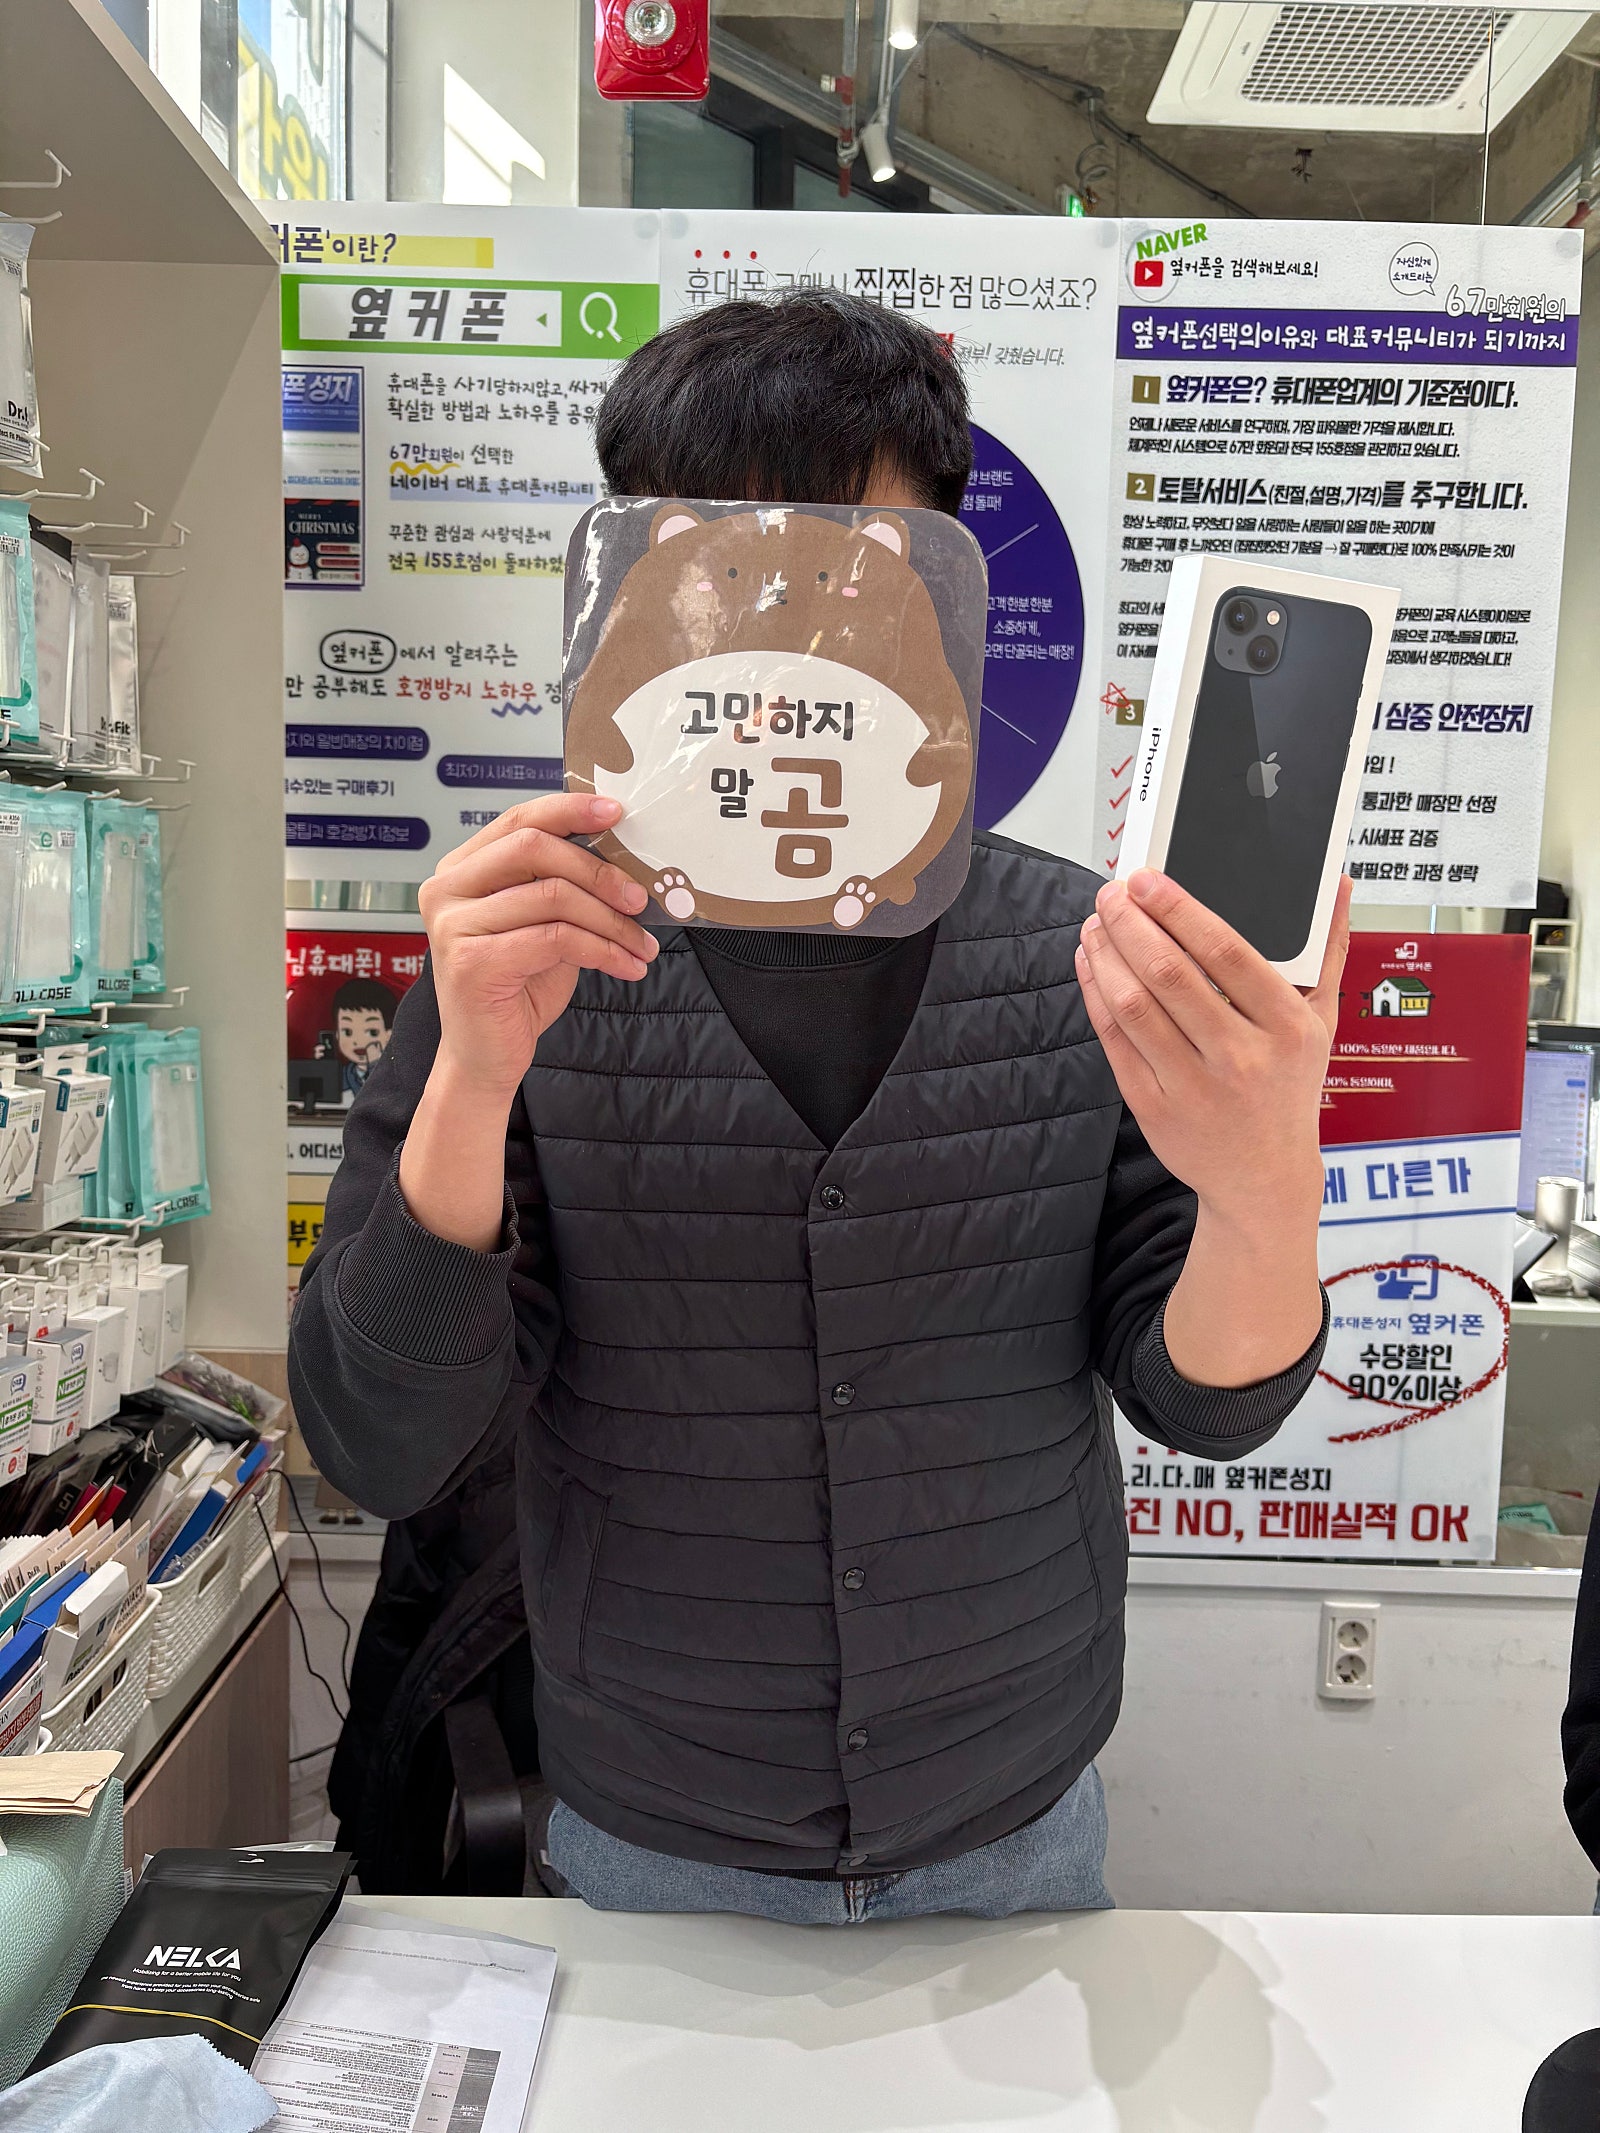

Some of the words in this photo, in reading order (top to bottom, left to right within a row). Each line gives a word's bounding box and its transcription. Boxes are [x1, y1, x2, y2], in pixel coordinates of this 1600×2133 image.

[1136, 223, 1208, 261] NAVER
[1171, 257, 1225, 279] 옆커폰을
[1230, 258, 1319, 278] 검색해보세요!
[1396, 256, 1432, 268] 자신있게
[854, 267, 945, 309] 찝찝한
[950, 275, 972, 309] 점
[980, 276, 1097, 311] 많으셨죠?
[1393, 271, 1434, 284] 소개드리는
[1445, 284, 1566, 323] 67만회원의
[1326, 322, 1477, 352] 대표커뮤니티가
[1484, 329, 1567, 353] 되기까지
[994, 346, 1065, 366] 갖췄습니다.
[309, 375, 352, 404] 성지
[387, 373, 447, 396] 휴대폰을
[1166, 374, 1267, 403] 옆커폰은?
[1271, 376, 1403, 407] 휴대폰업계의
[1405, 378, 1520, 409] 기준점이다.
[387, 397, 435, 422] 확실한
[442, 400, 491, 422] 방법과
[498, 401, 560, 425] 노하우를
[1129, 416, 1162, 432] 언제나
[1163, 418, 1197, 432] 새로운
[1292, 420, 1315, 434] 가장
[389, 443, 465, 463] 67만회원이
[471, 444, 514, 465] 선택한
[1291, 440, 1314, 456] 전국
[390, 475, 449, 491] 네이버
[456, 476, 491, 493] 대표
[1410, 480, 1528, 510] 추구합니다.
[288, 521, 355, 535] CHRISTMAS
[389, 524, 428, 542] 꾸준한
[434, 525, 475, 543] 관심과
[389, 552, 417, 571] 전국
[424, 551, 496, 572] 155호점이
[1411, 543, 1437, 556] 100%
[331, 641, 385, 665] 옆커폰
[400, 646, 436, 661] 에서
[445, 641, 518, 667] 알려주는
[313, 675, 388, 698] 공부해도
[396, 676, 472, 700] 호갱방지
[481, 681, 537, 701] 노하우
[680, 690, 854, 744] 고민하지
[1386, 702, 1434, 731] 삼중
[1437, 704, 1533, 733] 안전장치
[1140, 727, 1161, 801] iPhone
[336, 779, 394, 797] 구매후기
[1361, 791, 1411, 812] 통과한
[1416, 794, 1463, 813] 매장만
[1466, 795, 1497, 814] 선정
[710, 767, 755, 819] 말
[760, 757, 850, 880] 곰
[1359, 828, 1404, 847] 시세표
[1409, 829, 1439, 848] 검증
[1350, 862, 1409, 881] 불필요한
[1412, 863, 1443, 881] 과정
[1447, 864, 1480, 883] 생략
[1338, 1043, 1369, 1055] 100%
[1365, 1156, 1472, 1202] 다른가
[1332, 1315, 1402, 1331] 휴대폰성지
[1408, 1312, 1485, 1337] 옆커폰
[1360, 1343, 1454, 1371] 수당할인
[1348, 1373, 1463, 1402] 90%이상
[1225, 1466, 1331, 1491] 옆커폰성지
[1176, 1498, 1244, 1543] NO,
[1258, 1500, 1397, 1541] 판매실적
[1411, 1503, 1469, 1542] OK
[175, 1970, 193, 1978] better
[230, 1974, 242, 1982] you
